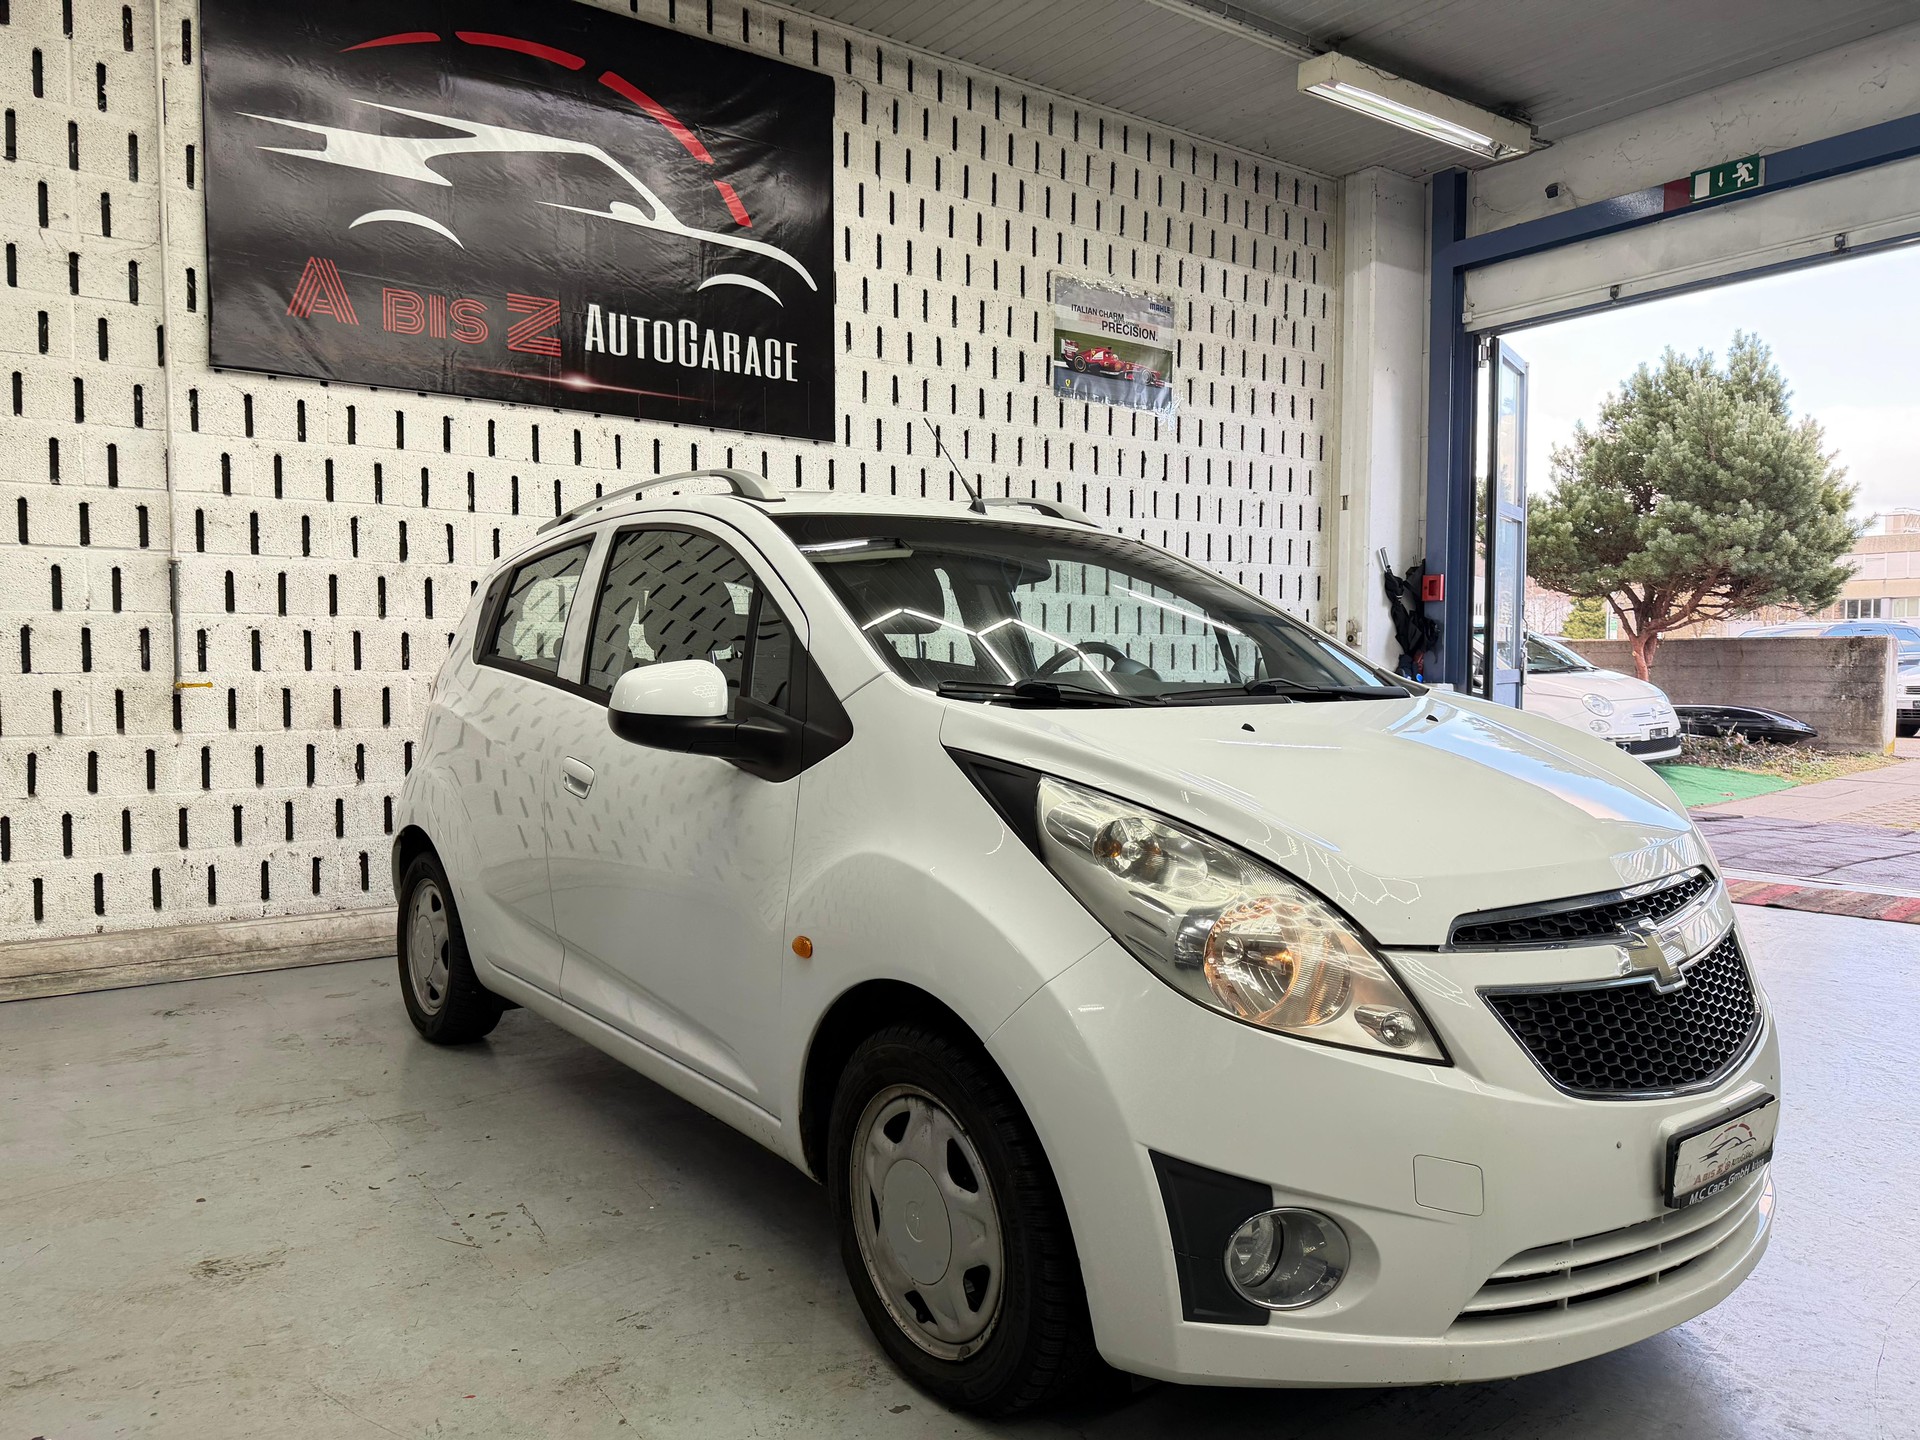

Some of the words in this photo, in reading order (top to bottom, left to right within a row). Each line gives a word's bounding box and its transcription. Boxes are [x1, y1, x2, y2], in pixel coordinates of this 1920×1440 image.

[285, 256, 360, 326] A
[382, 287, 489, 344] BIS
[507, 292, 562, 357] Z
[1071, 303, 1098, 316] ITALIAN
[1098, 309, 1125, 321] CHARM
[1149, 302, 1171, 314] MAHLE
[1101, 320, 1158, 342] PRECISION.
[1707, 1180, 1727, 1196] Cars
[1728, 1163, 1751, 1184] GmbH
